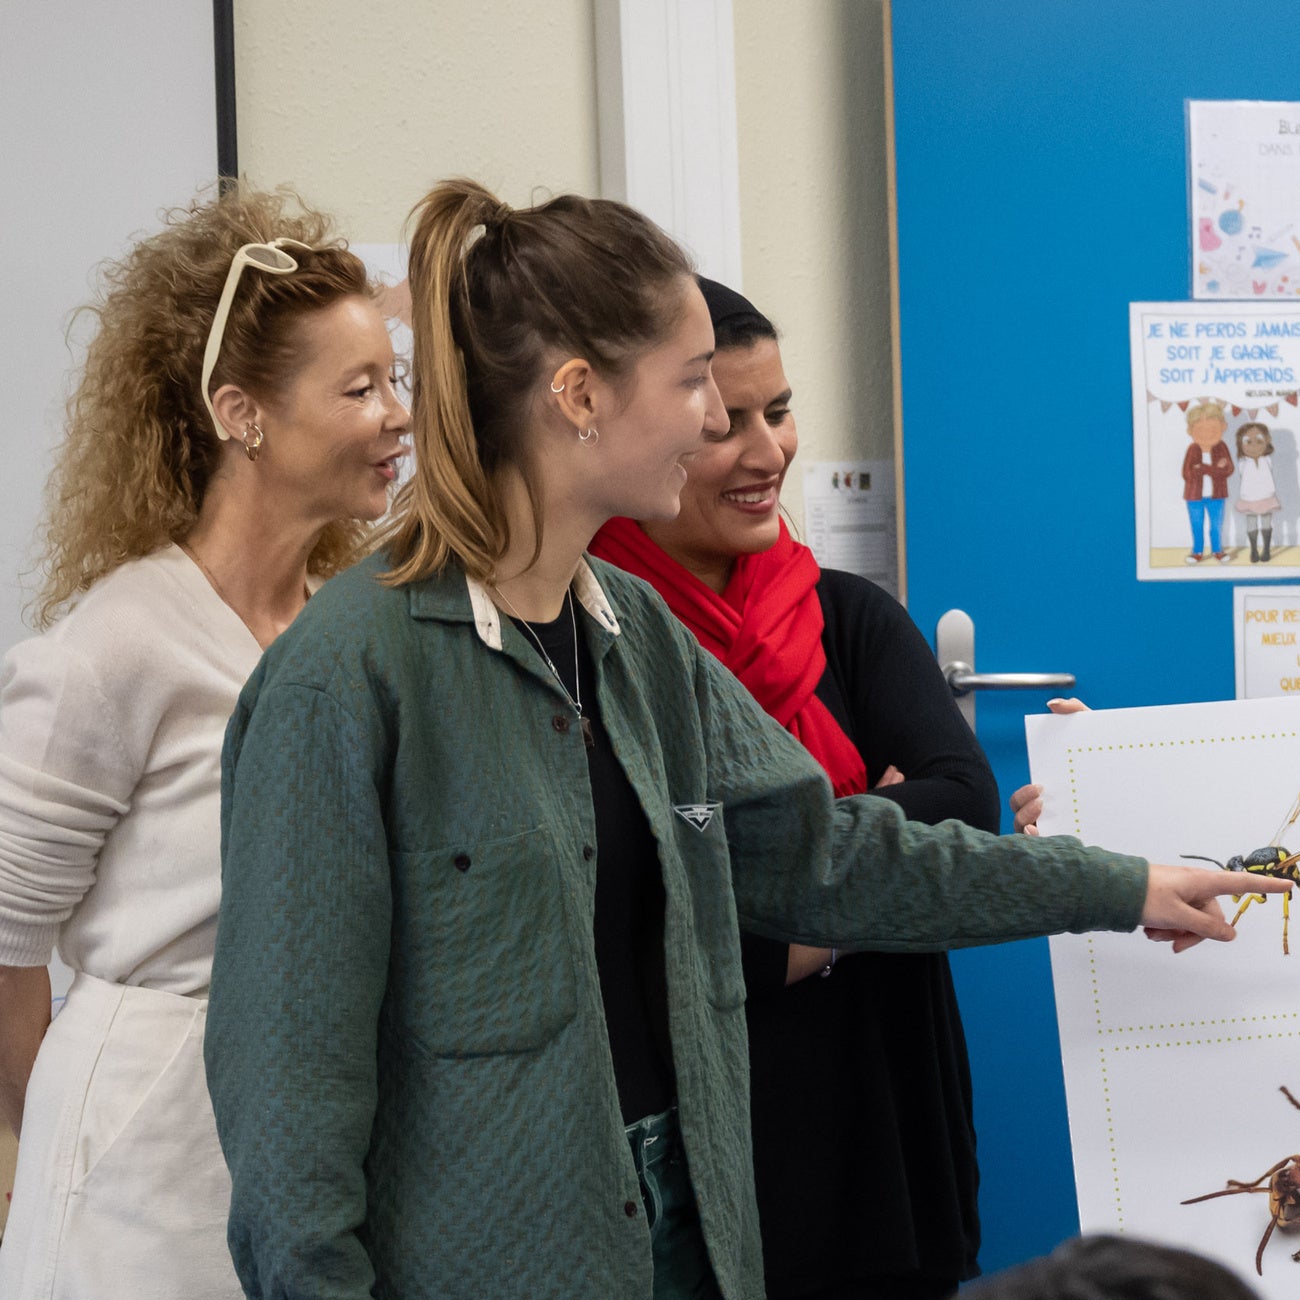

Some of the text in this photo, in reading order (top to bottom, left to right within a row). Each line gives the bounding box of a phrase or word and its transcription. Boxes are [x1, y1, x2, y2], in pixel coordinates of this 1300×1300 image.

[1147, 322, 1163, 339] JE
[1169, 321, 1189, 338] NE
[1196, 322, 1247, 338] PERDS
[1167, 344, 1283, 363] SOIT JE GAGNE,
[1160, 368, 1194, 384] SOIT
[1245, 609, 1279, 623] POUR
